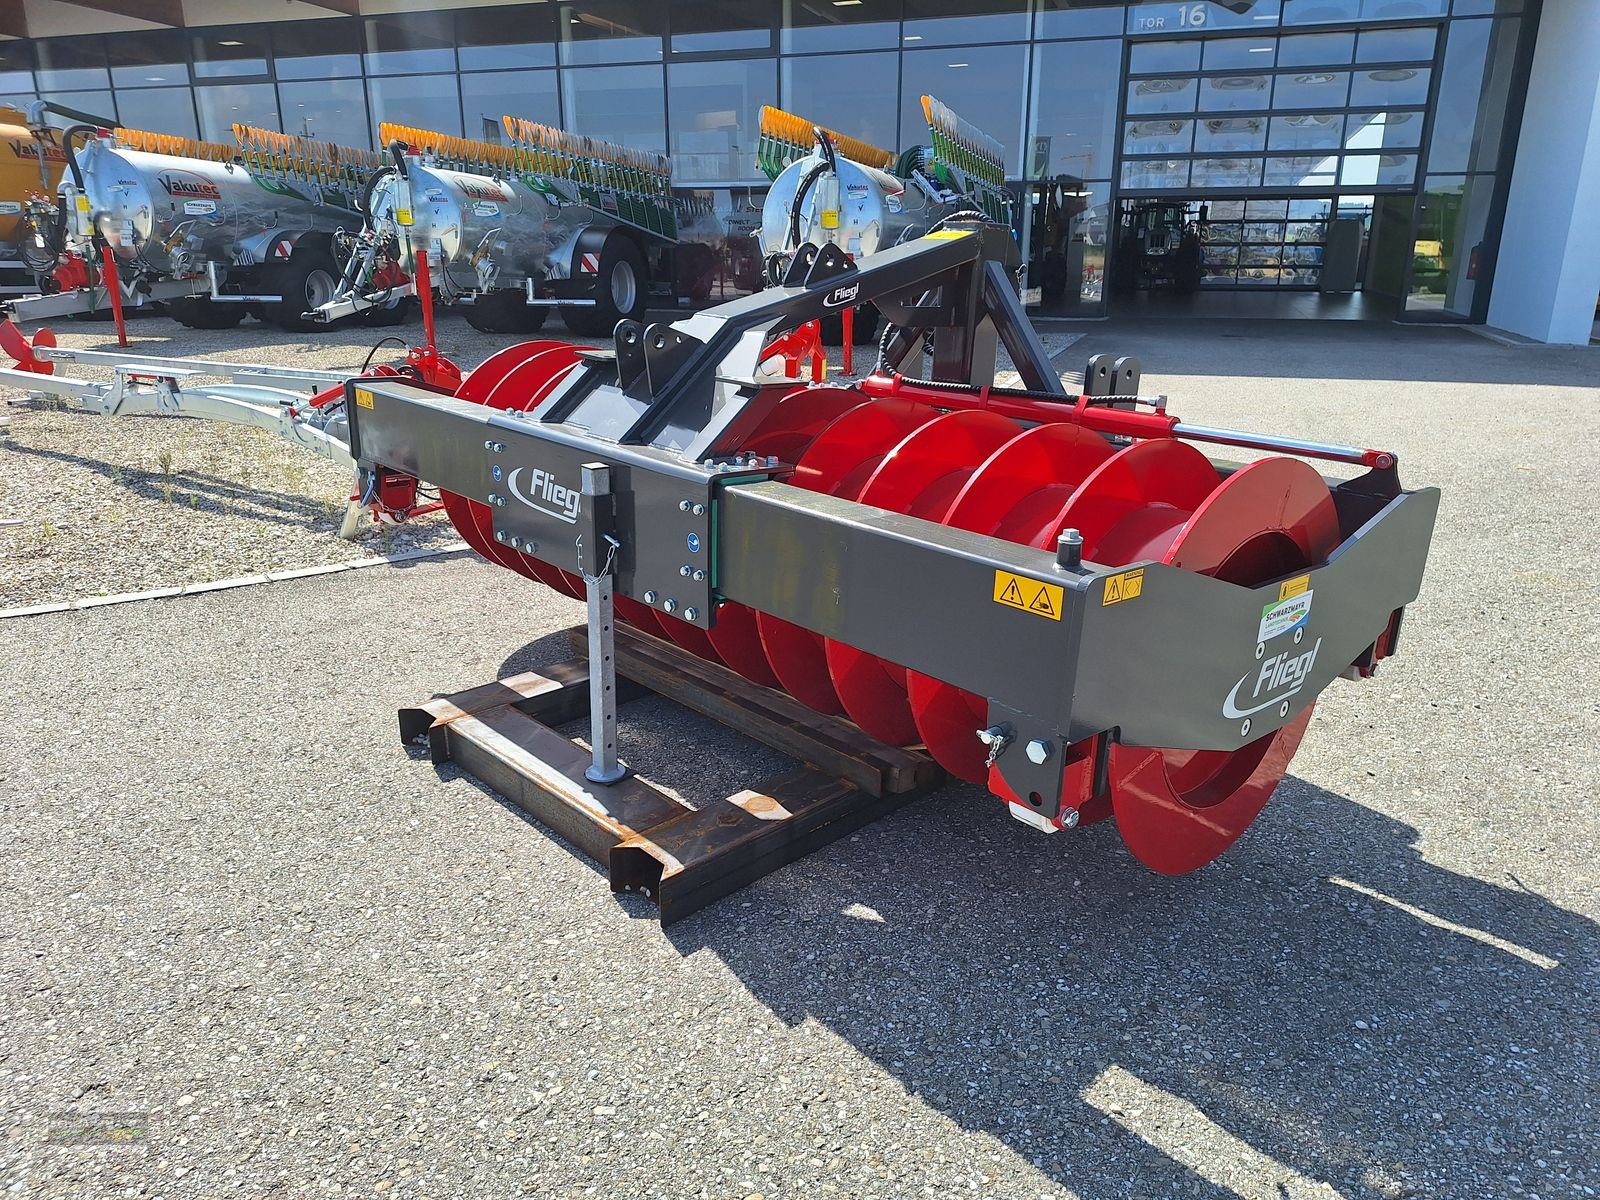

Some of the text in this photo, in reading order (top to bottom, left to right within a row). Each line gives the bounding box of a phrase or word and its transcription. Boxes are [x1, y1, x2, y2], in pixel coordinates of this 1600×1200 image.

[1139, 4, 1206, 28] TOR 16
[157, 174, 220, 196] Vakutec
[834, 282, 860, 302] Fliegl
[530, 468, 582, 519] Flieg
[1265, 601, 1306, 622] SCHWARZMAYR
[1252, 637, 1322, 699] Fliegl
